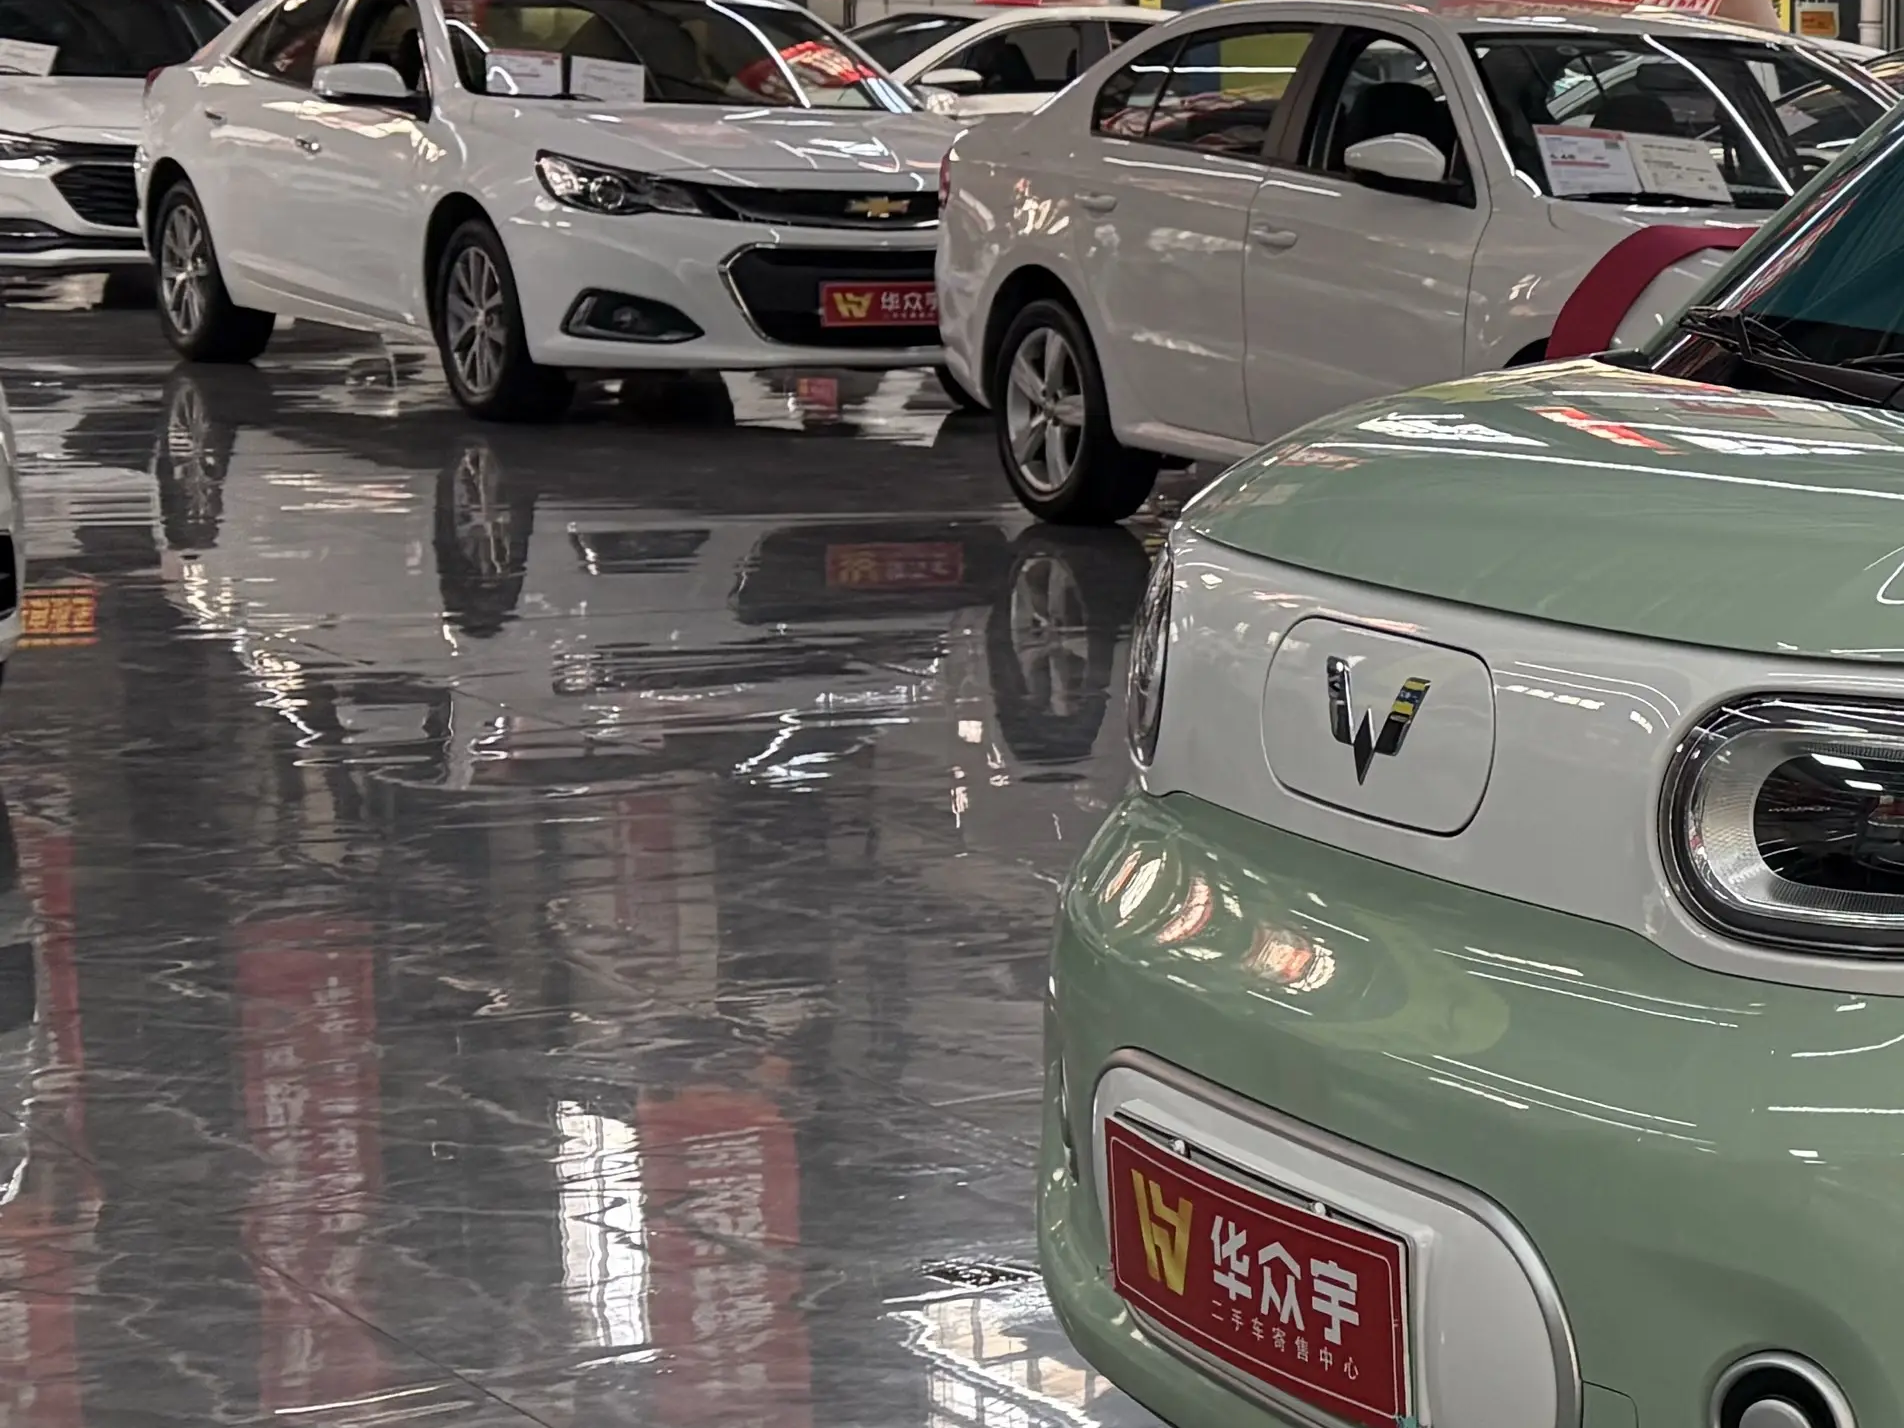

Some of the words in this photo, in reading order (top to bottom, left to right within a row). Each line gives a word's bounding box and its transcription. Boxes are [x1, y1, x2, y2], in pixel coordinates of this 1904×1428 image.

[1210, 1215, 1359, 1345] 华众宇
[1212, 1299, 1358, 1380] 二手车寄售中心
